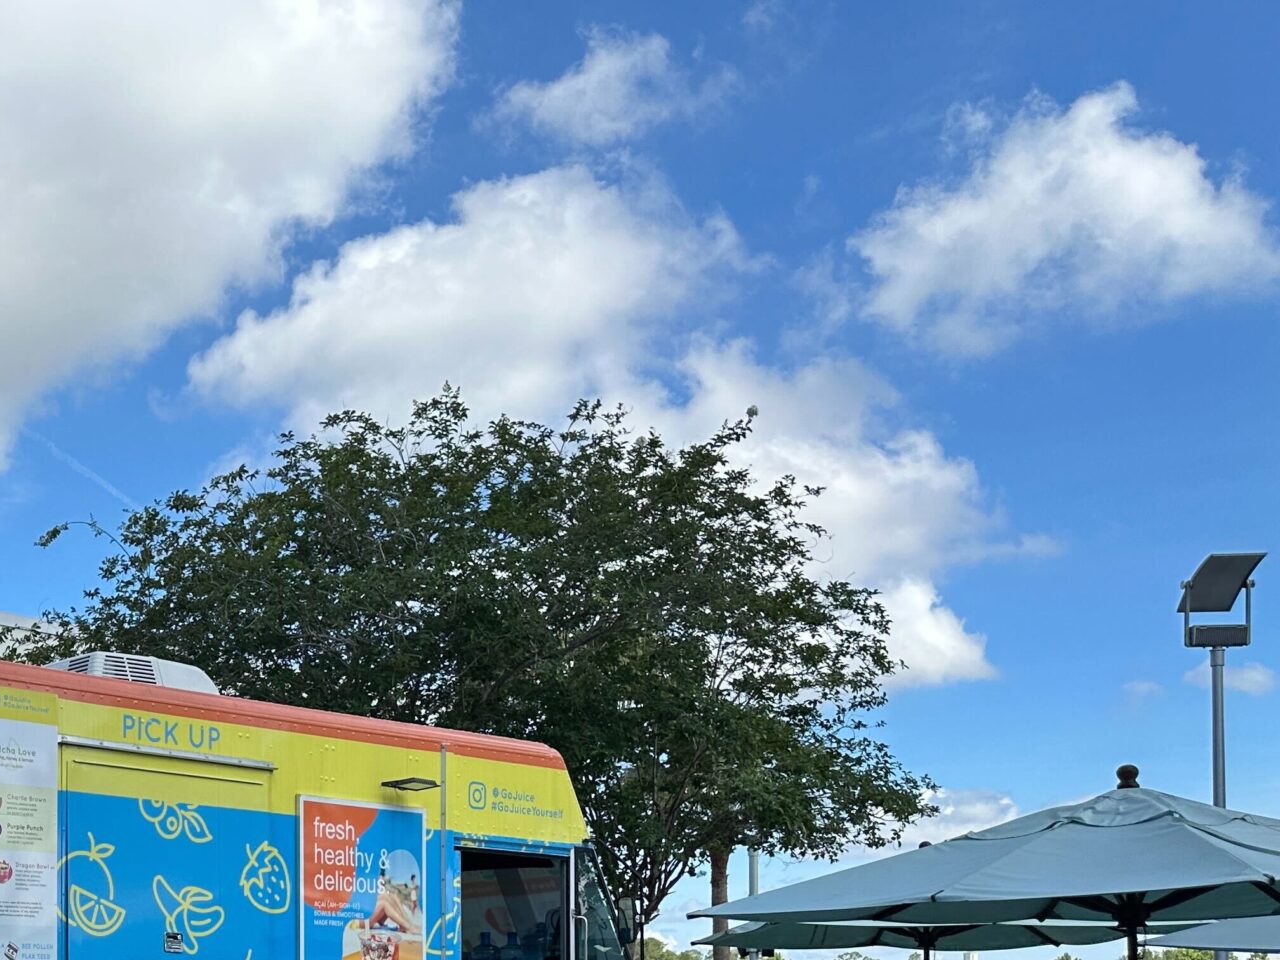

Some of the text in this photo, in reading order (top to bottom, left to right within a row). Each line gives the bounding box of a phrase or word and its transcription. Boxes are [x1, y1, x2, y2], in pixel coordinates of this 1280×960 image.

[123, 714, 220, 750] PICK UP
[18, 748, 36, 757] Love
[30, 796, 47, 804] Brown
[492, 801, 563, 819] #GoJuiceYourself
[7, 823, 26, 833] Purple
[313, 816, 360, 845] fresh,
[15, 863, 36, 871] Dragon
[314, 842, 390, 874] healthy &
[314, 869, 390, 896] delicious.
